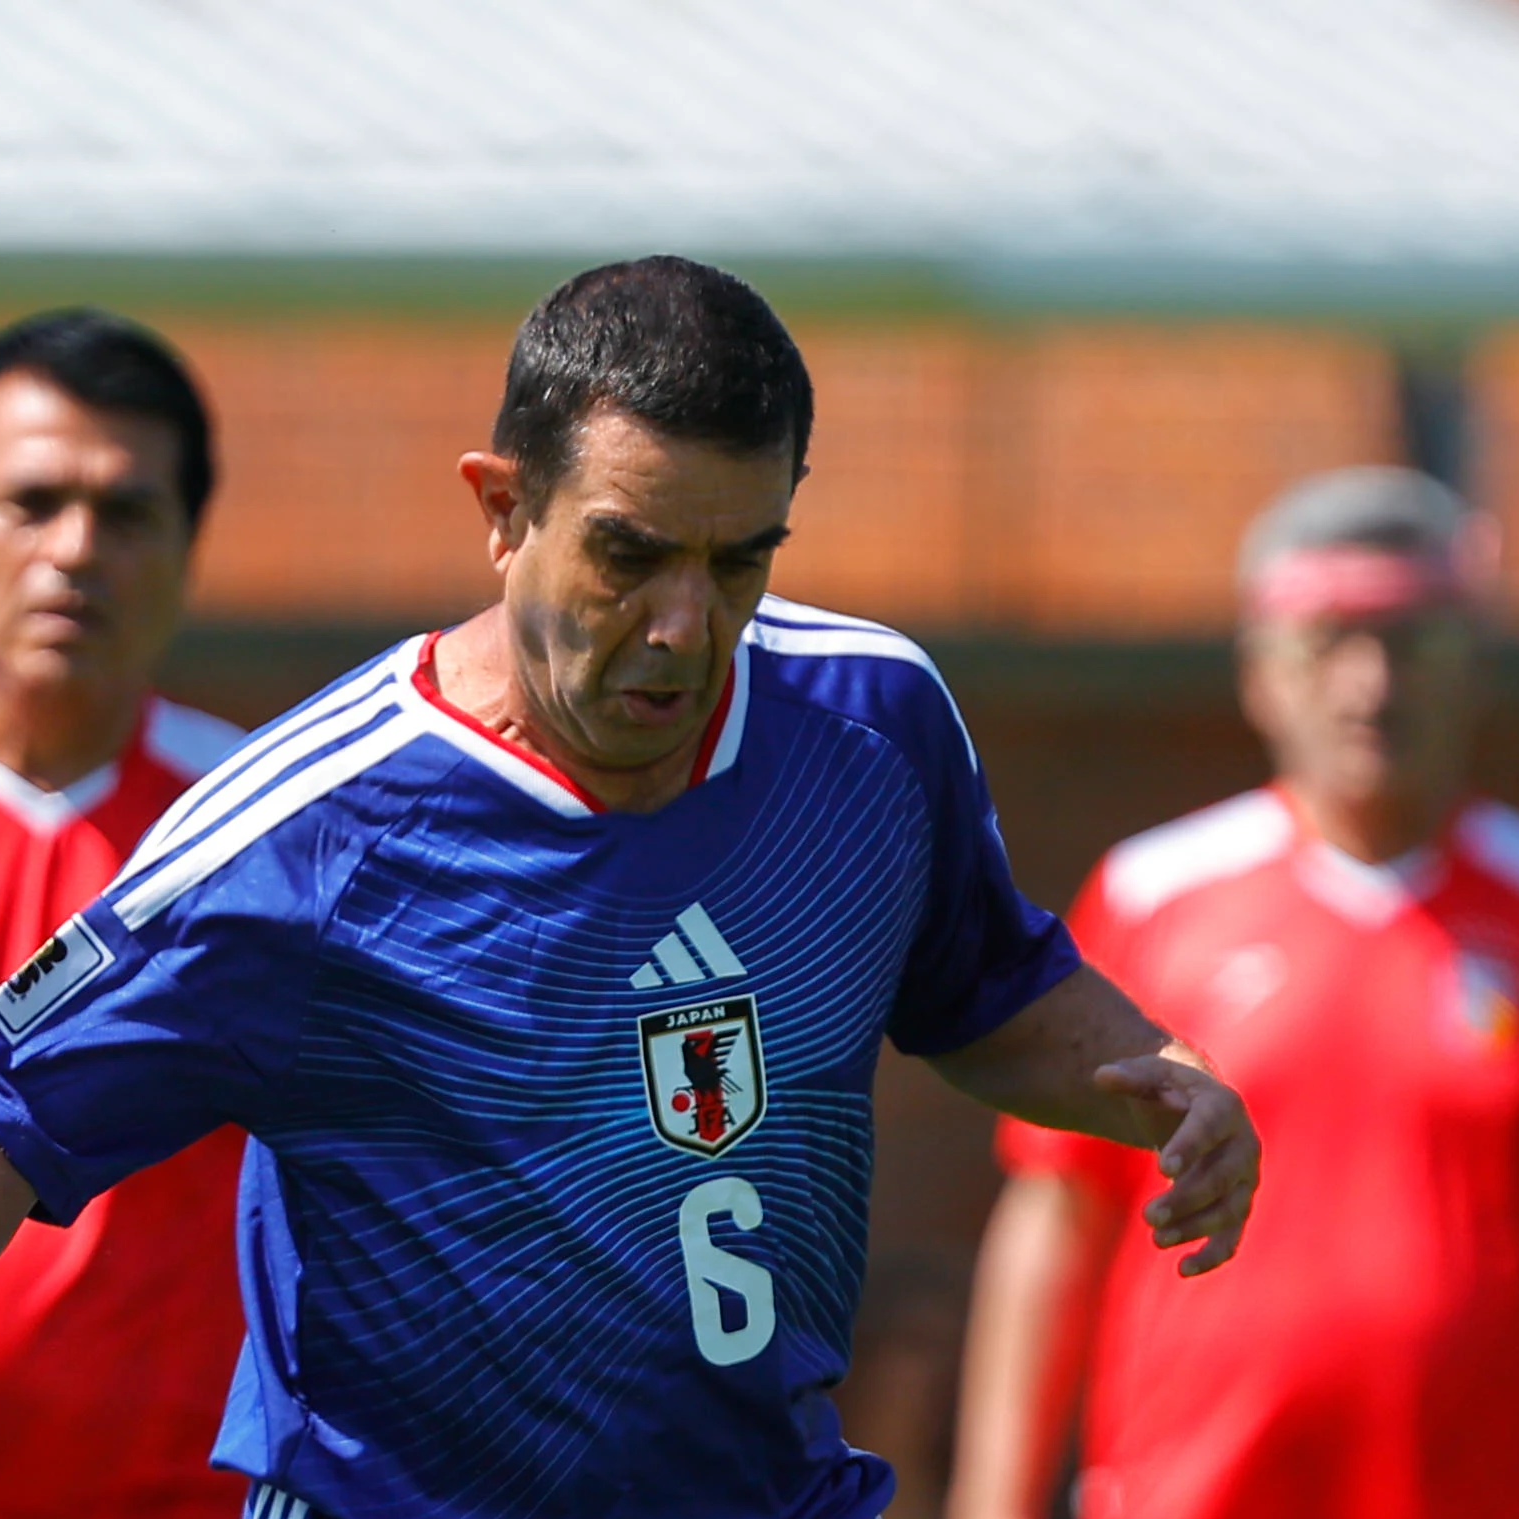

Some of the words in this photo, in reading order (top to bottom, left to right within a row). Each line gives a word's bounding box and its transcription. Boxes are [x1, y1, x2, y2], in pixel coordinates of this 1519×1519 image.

[666, 1004, 726, 1028] JAPAN
[688, 1112, 736, 1136] JFA
[679, 1177, 776, 1366] 6
